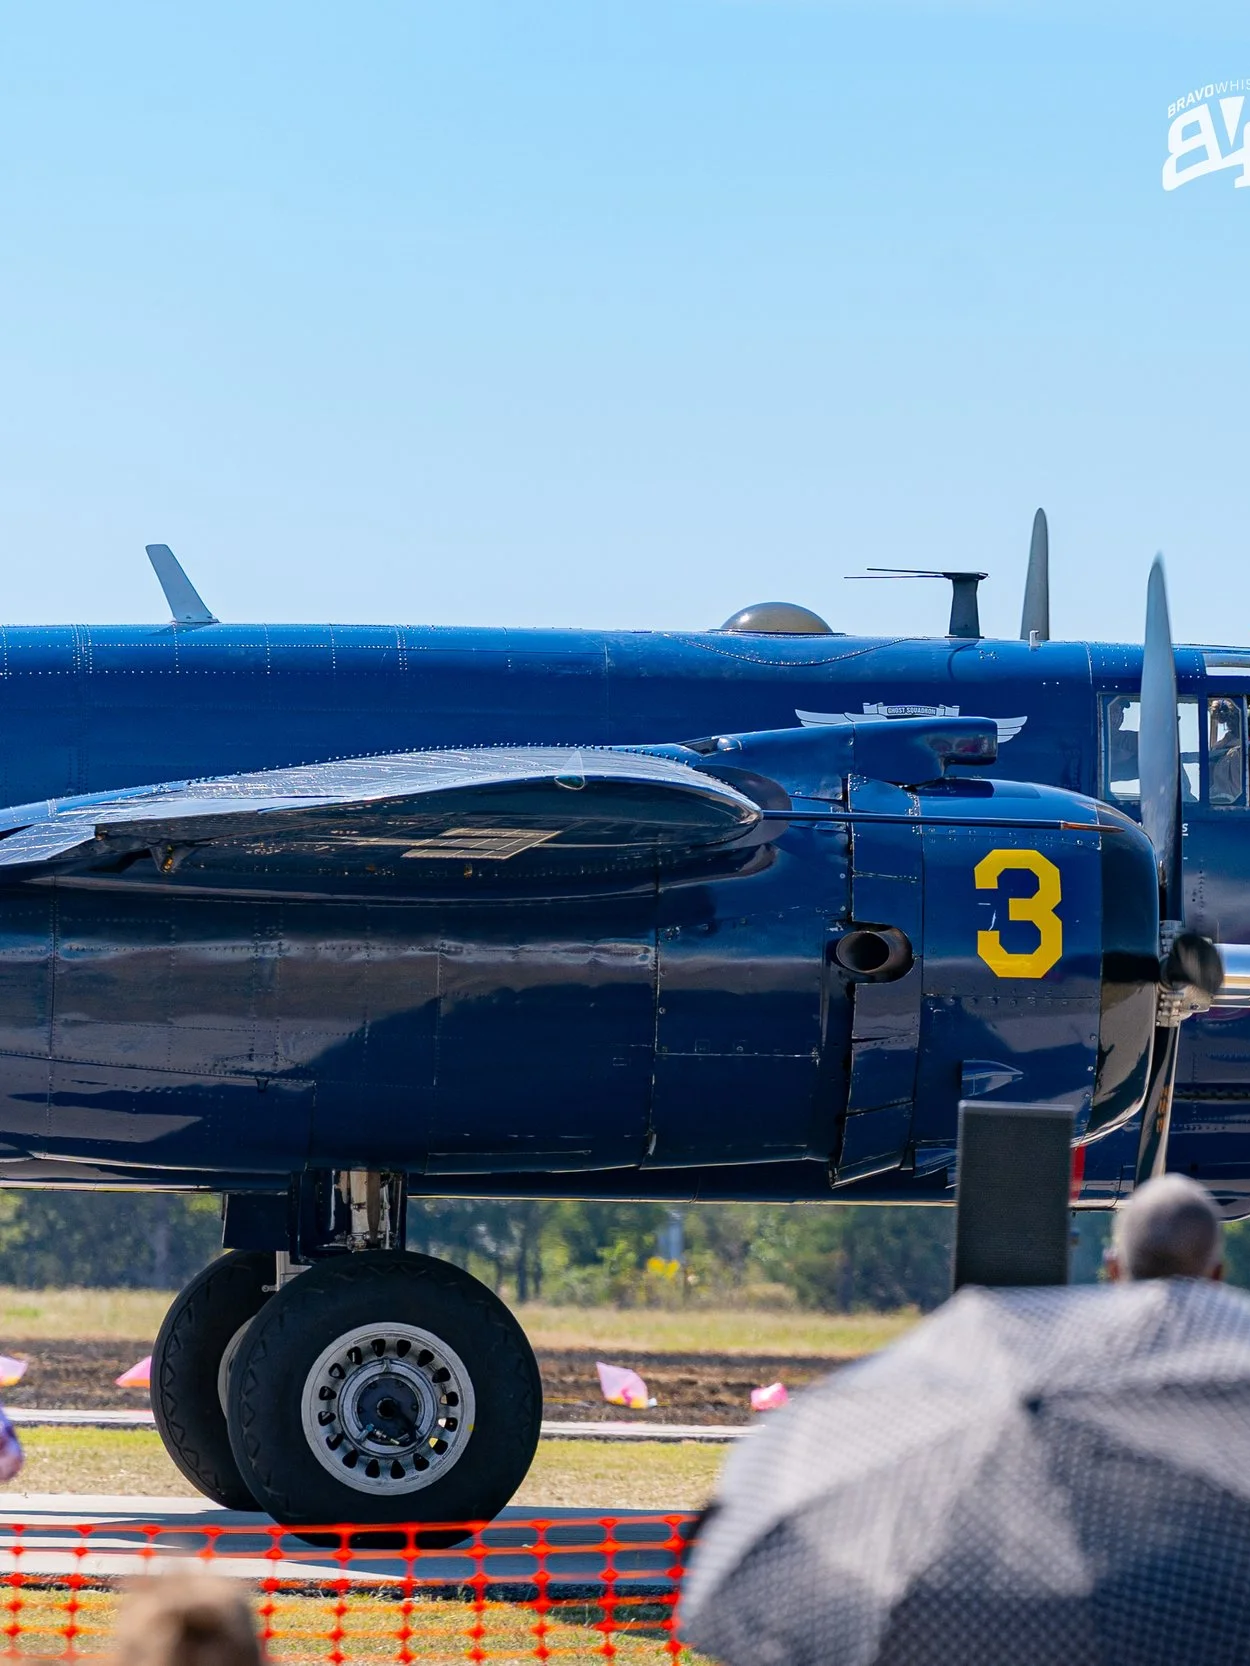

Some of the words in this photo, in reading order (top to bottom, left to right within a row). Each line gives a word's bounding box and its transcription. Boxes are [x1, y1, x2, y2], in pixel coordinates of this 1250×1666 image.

[888, 706, 905, 714] GHOST
[906, 706, 936, 715] SQUADRON
[974, 849, 1063, 978] 3
